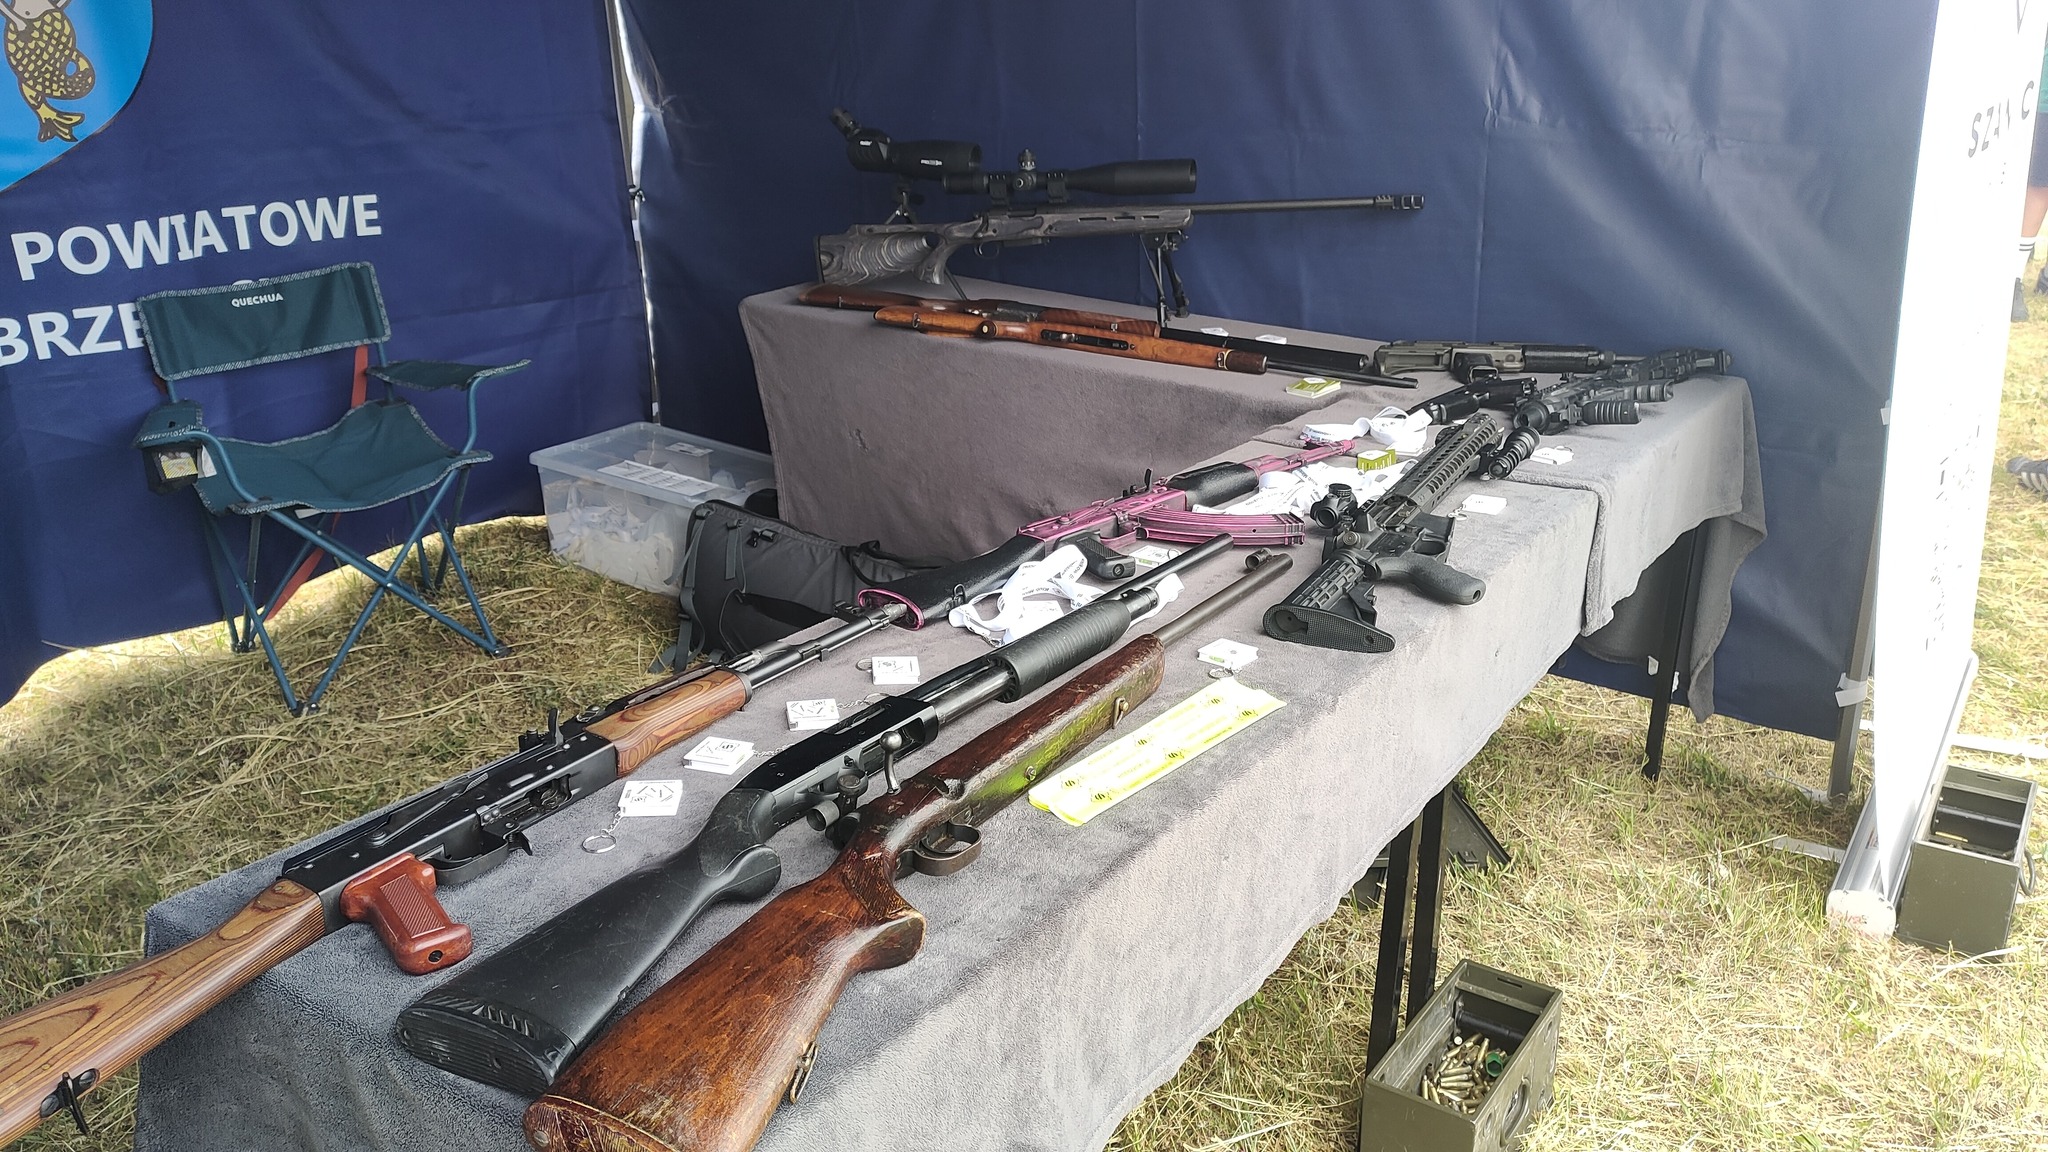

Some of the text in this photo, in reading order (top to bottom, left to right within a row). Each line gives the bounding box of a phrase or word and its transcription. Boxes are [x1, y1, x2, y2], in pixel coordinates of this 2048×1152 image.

[10, 194, 382, 281] POWIATOWE
[231, 292, 284, 308] QUECHUA
[0, 303, 146, 367] BRZE
